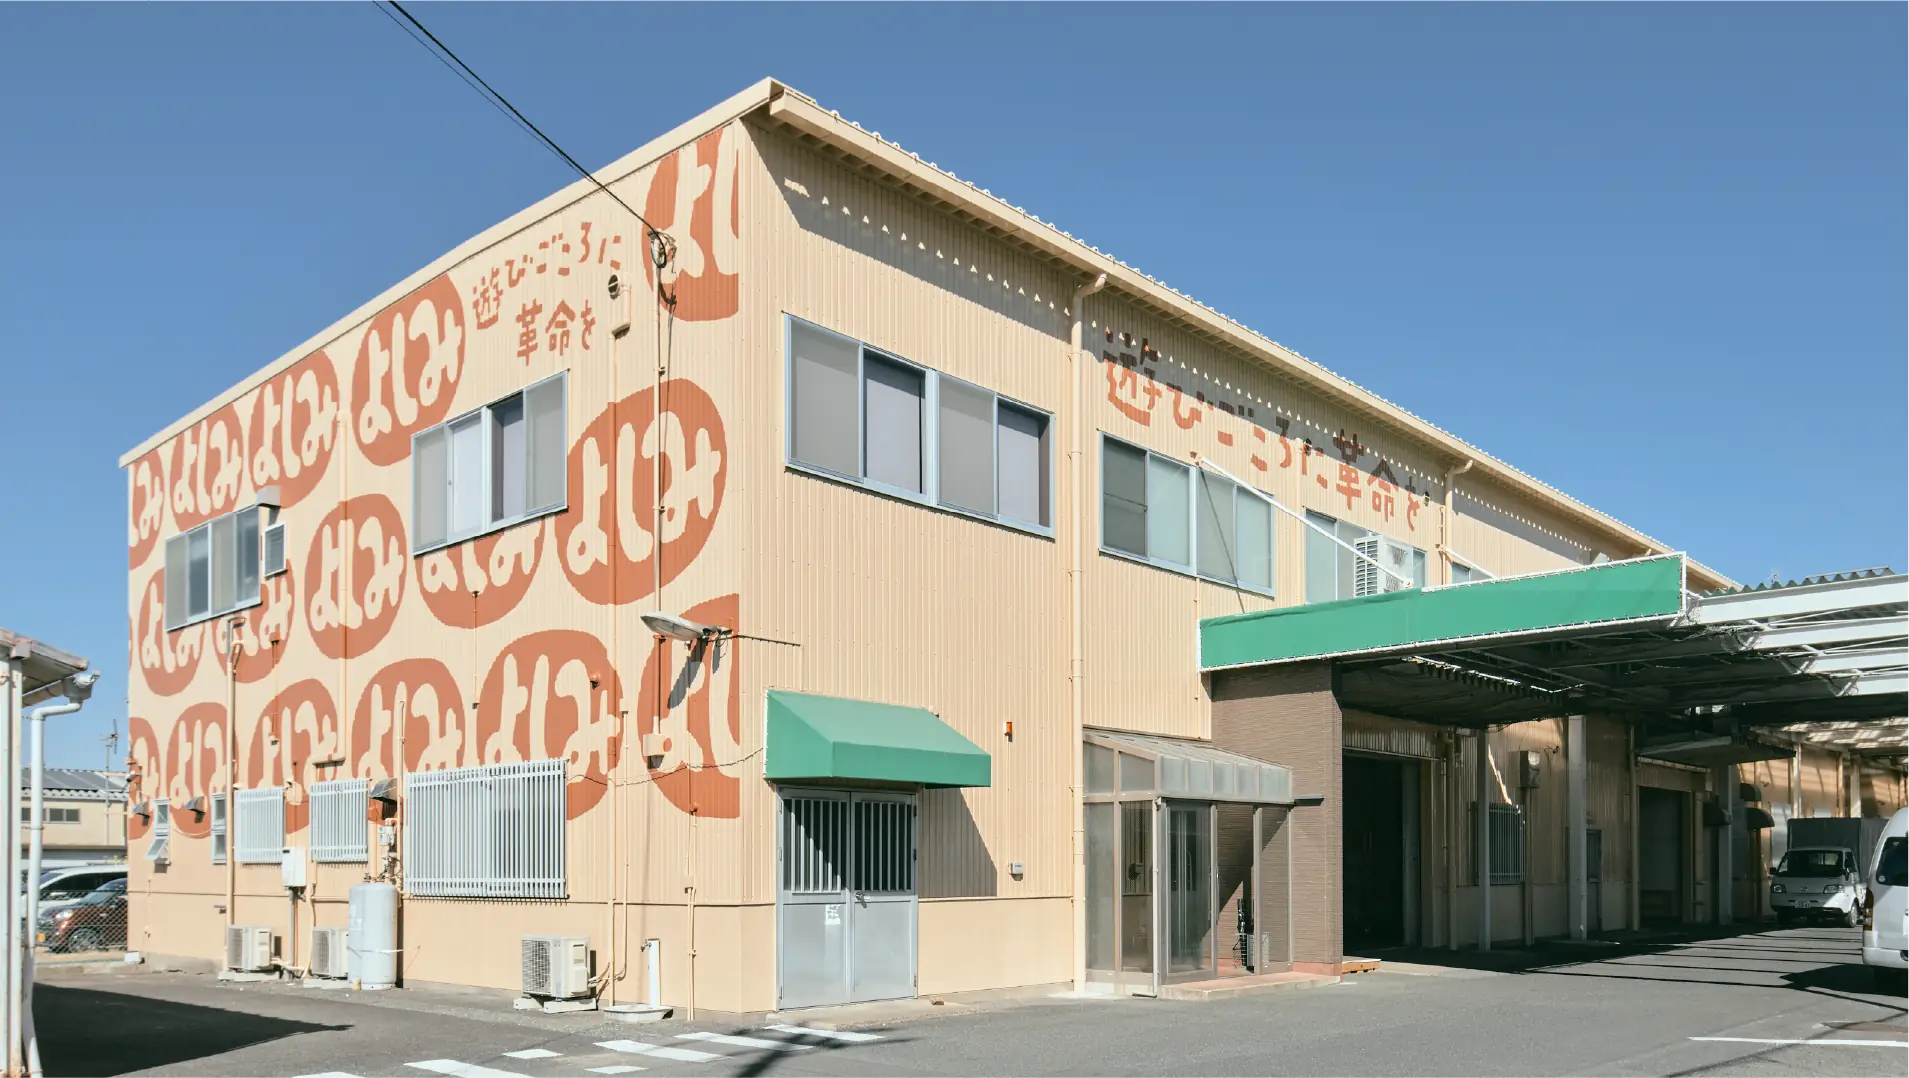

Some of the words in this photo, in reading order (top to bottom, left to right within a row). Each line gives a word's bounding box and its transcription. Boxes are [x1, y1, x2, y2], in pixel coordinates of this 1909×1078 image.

[473, 222, 621, 330] 遊びごころに
[360, 300, 462, 444] よしみ
[516, 299, 596, 366] 革命を
[173, 420, 243, 515] よしみ
[253, 369, 339, 485] よしみ
[568, 411, 722, 575] よしみ
